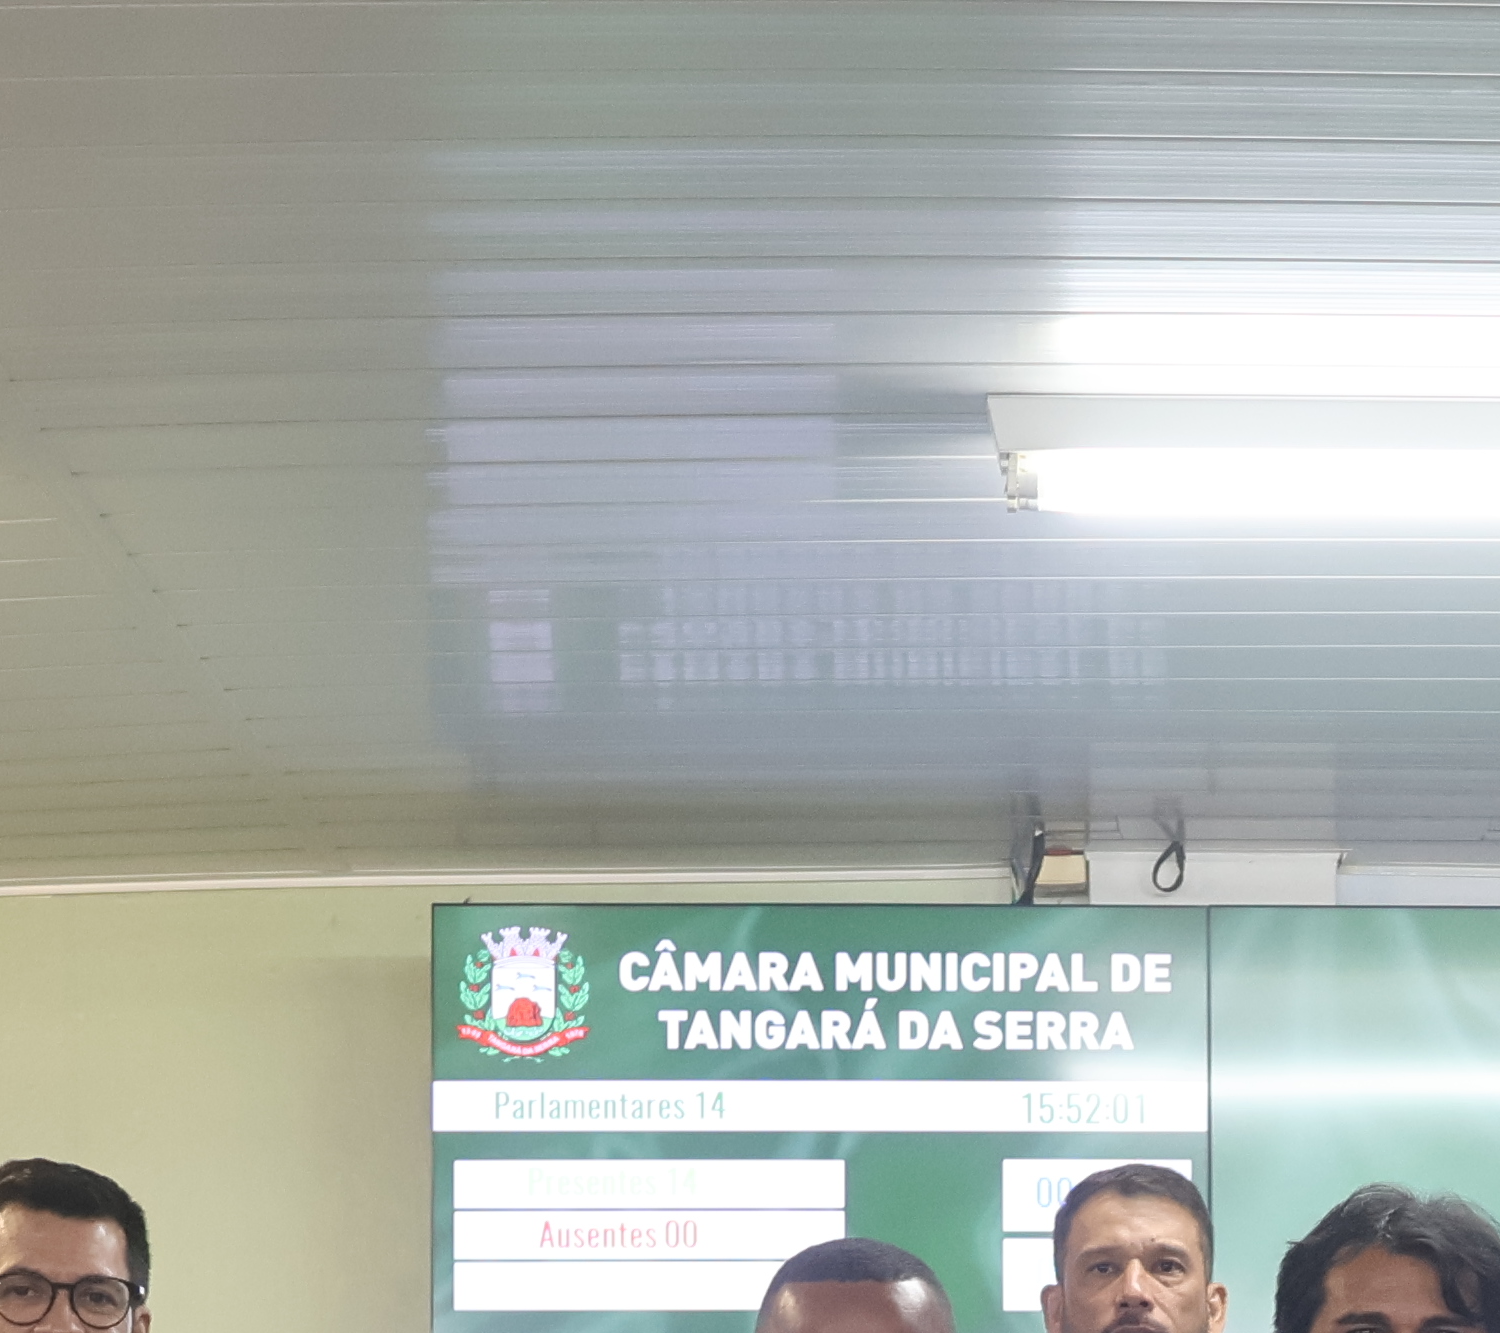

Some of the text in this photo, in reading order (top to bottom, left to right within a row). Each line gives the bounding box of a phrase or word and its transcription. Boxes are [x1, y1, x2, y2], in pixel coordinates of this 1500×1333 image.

[618, 938, 1172, 993] CÂMARA MUNICIPAL DE
[657, 998, 1134, 1052] TANGARÁ DA SERRA
[493, 1091, 726, 1120] Parlamentares 14
[1022, 1093, 1147, 1124] 15:52:01
[539, 1220, 698, 1250] Ausentes 00
